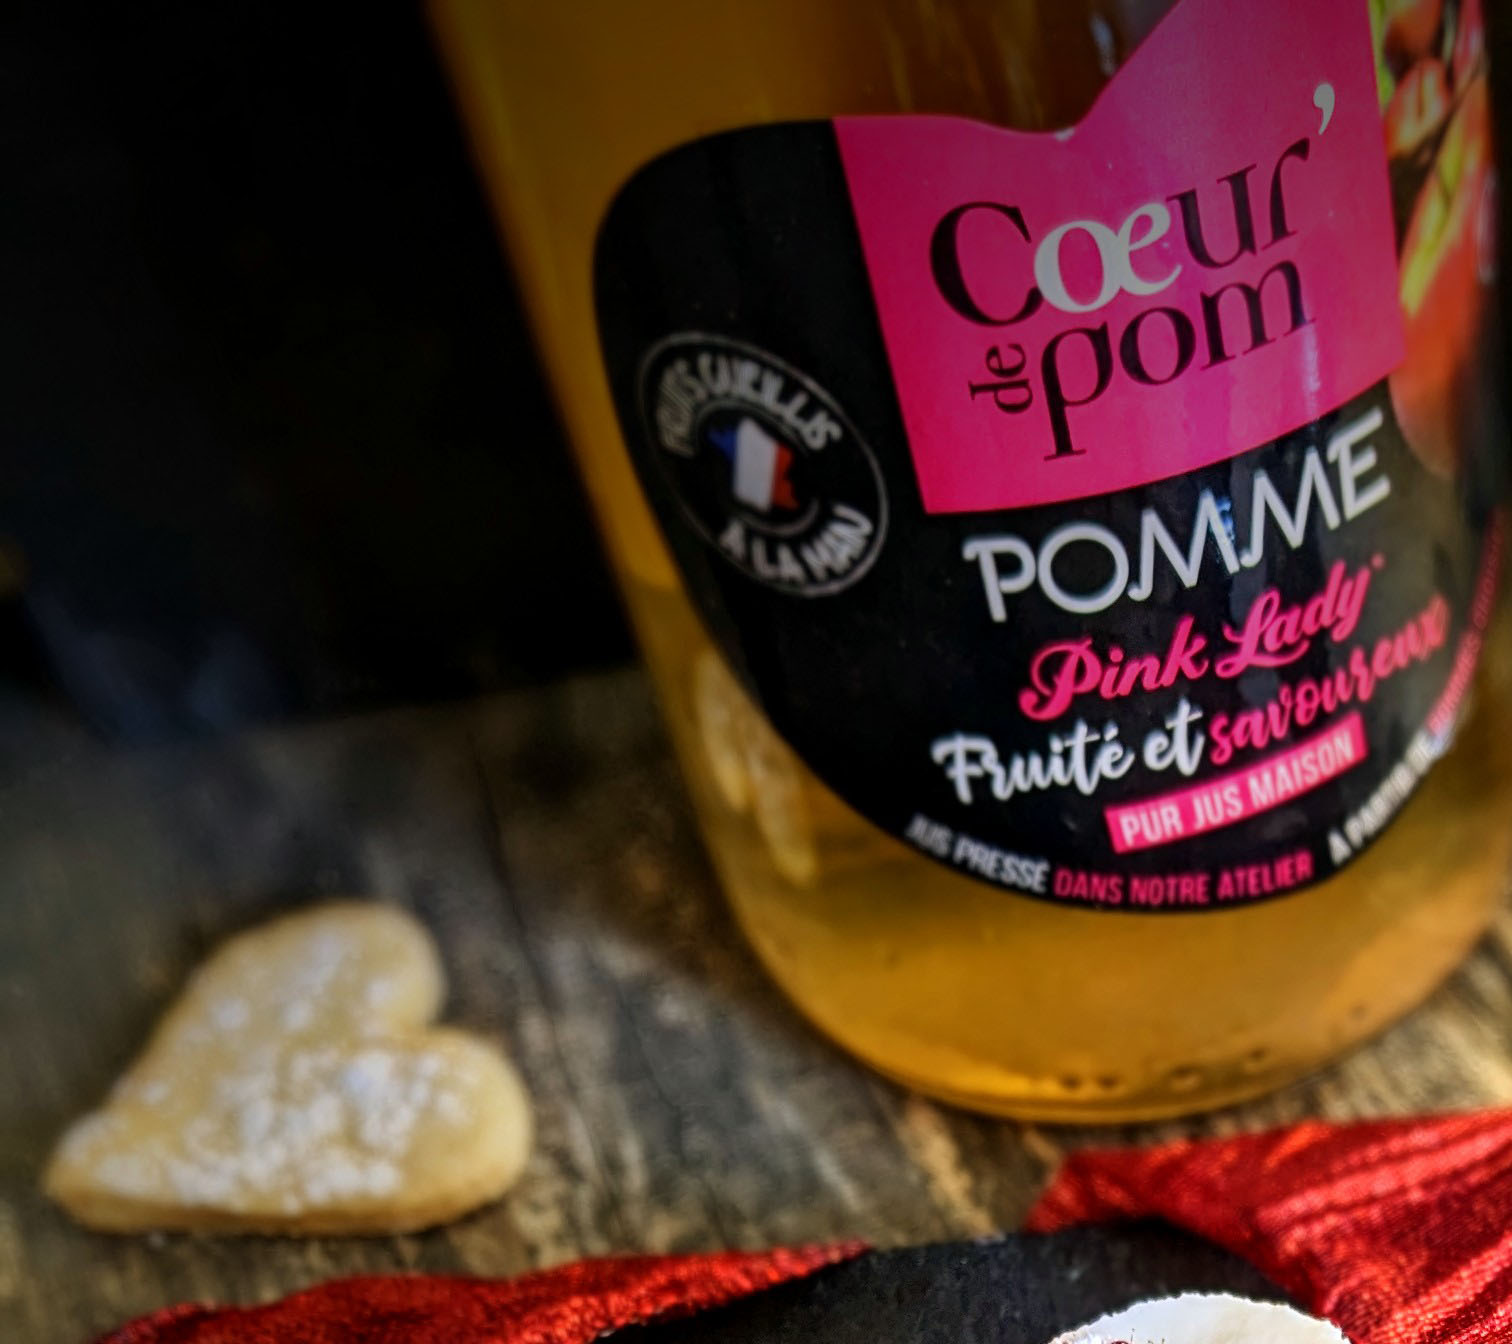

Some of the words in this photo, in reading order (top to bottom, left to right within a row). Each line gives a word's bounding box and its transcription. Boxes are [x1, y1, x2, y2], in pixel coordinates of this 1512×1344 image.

[968, 342, 1034, 414] de
[1041, 260, 1316, 462] pom
[961, 406, 1392, 623] POMME
[930, 718, 1136, 804] Fruité
[1143, 695, 1204, 776] et
[1208, 593, 1451, 766] savoureux
[1018, 616, 1209, 722] Pink
[1119, 806, 1184, 847] PUR
[1192, 783, 1244, 830] JUS
[1249, 728, 1356, 808] MAISON
[1052, 867, 1124, 902] DANS
[1127, 871, 1211, 906] NOTRE
[1216, 849, 1314, 900] ATELIER
